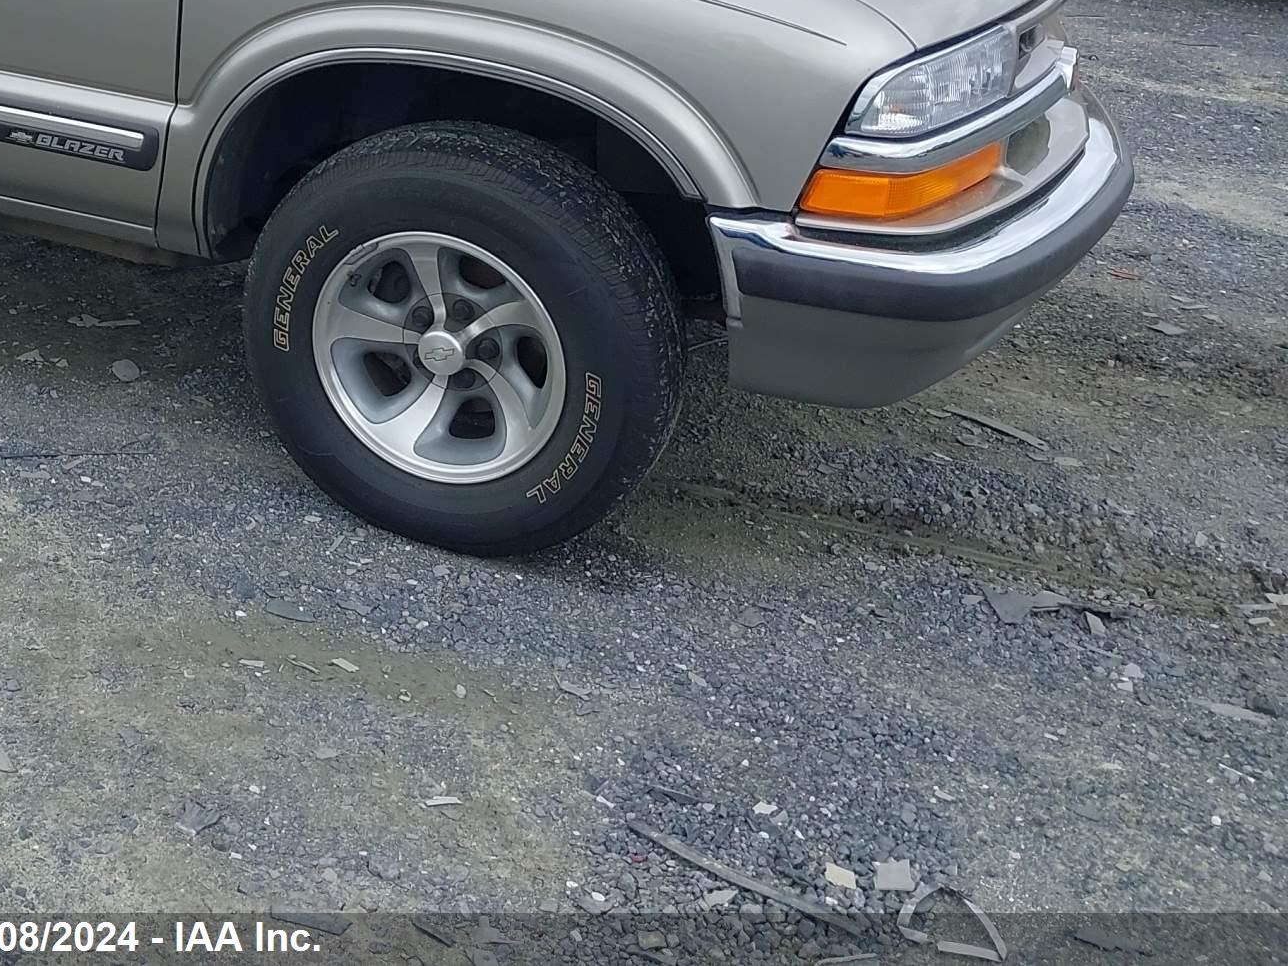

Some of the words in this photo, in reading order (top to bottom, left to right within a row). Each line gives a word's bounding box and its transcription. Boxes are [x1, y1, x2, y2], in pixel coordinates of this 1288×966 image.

[35, 133, 126, 162] BLAZER
[272, 224, 340, 353] GENERAL
[525, 371, 603, 505] GENERAL
